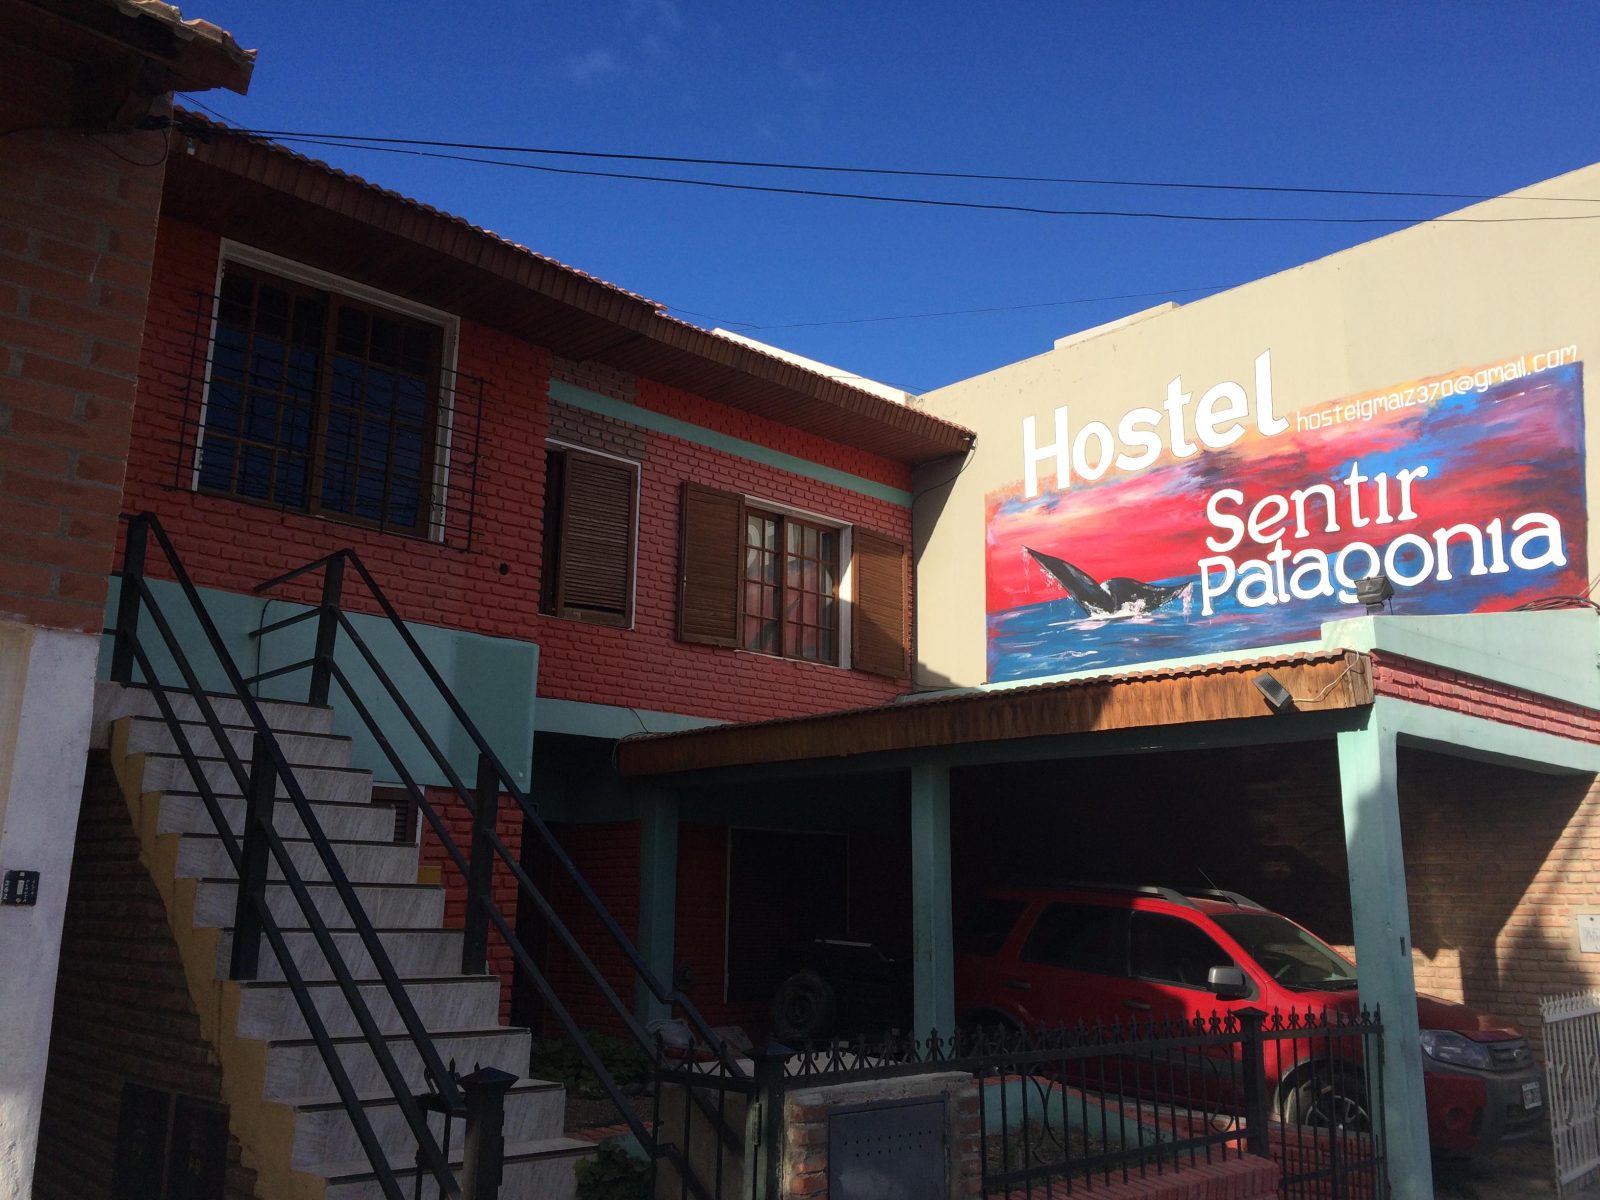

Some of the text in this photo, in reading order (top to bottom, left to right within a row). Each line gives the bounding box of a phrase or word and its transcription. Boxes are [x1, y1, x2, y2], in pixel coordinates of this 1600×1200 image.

[1022, 349, 1290, 498] Hostel
[1205, 461, 1429, 552] Sentir
[1198, 512, 1567, 616] Patagonia
